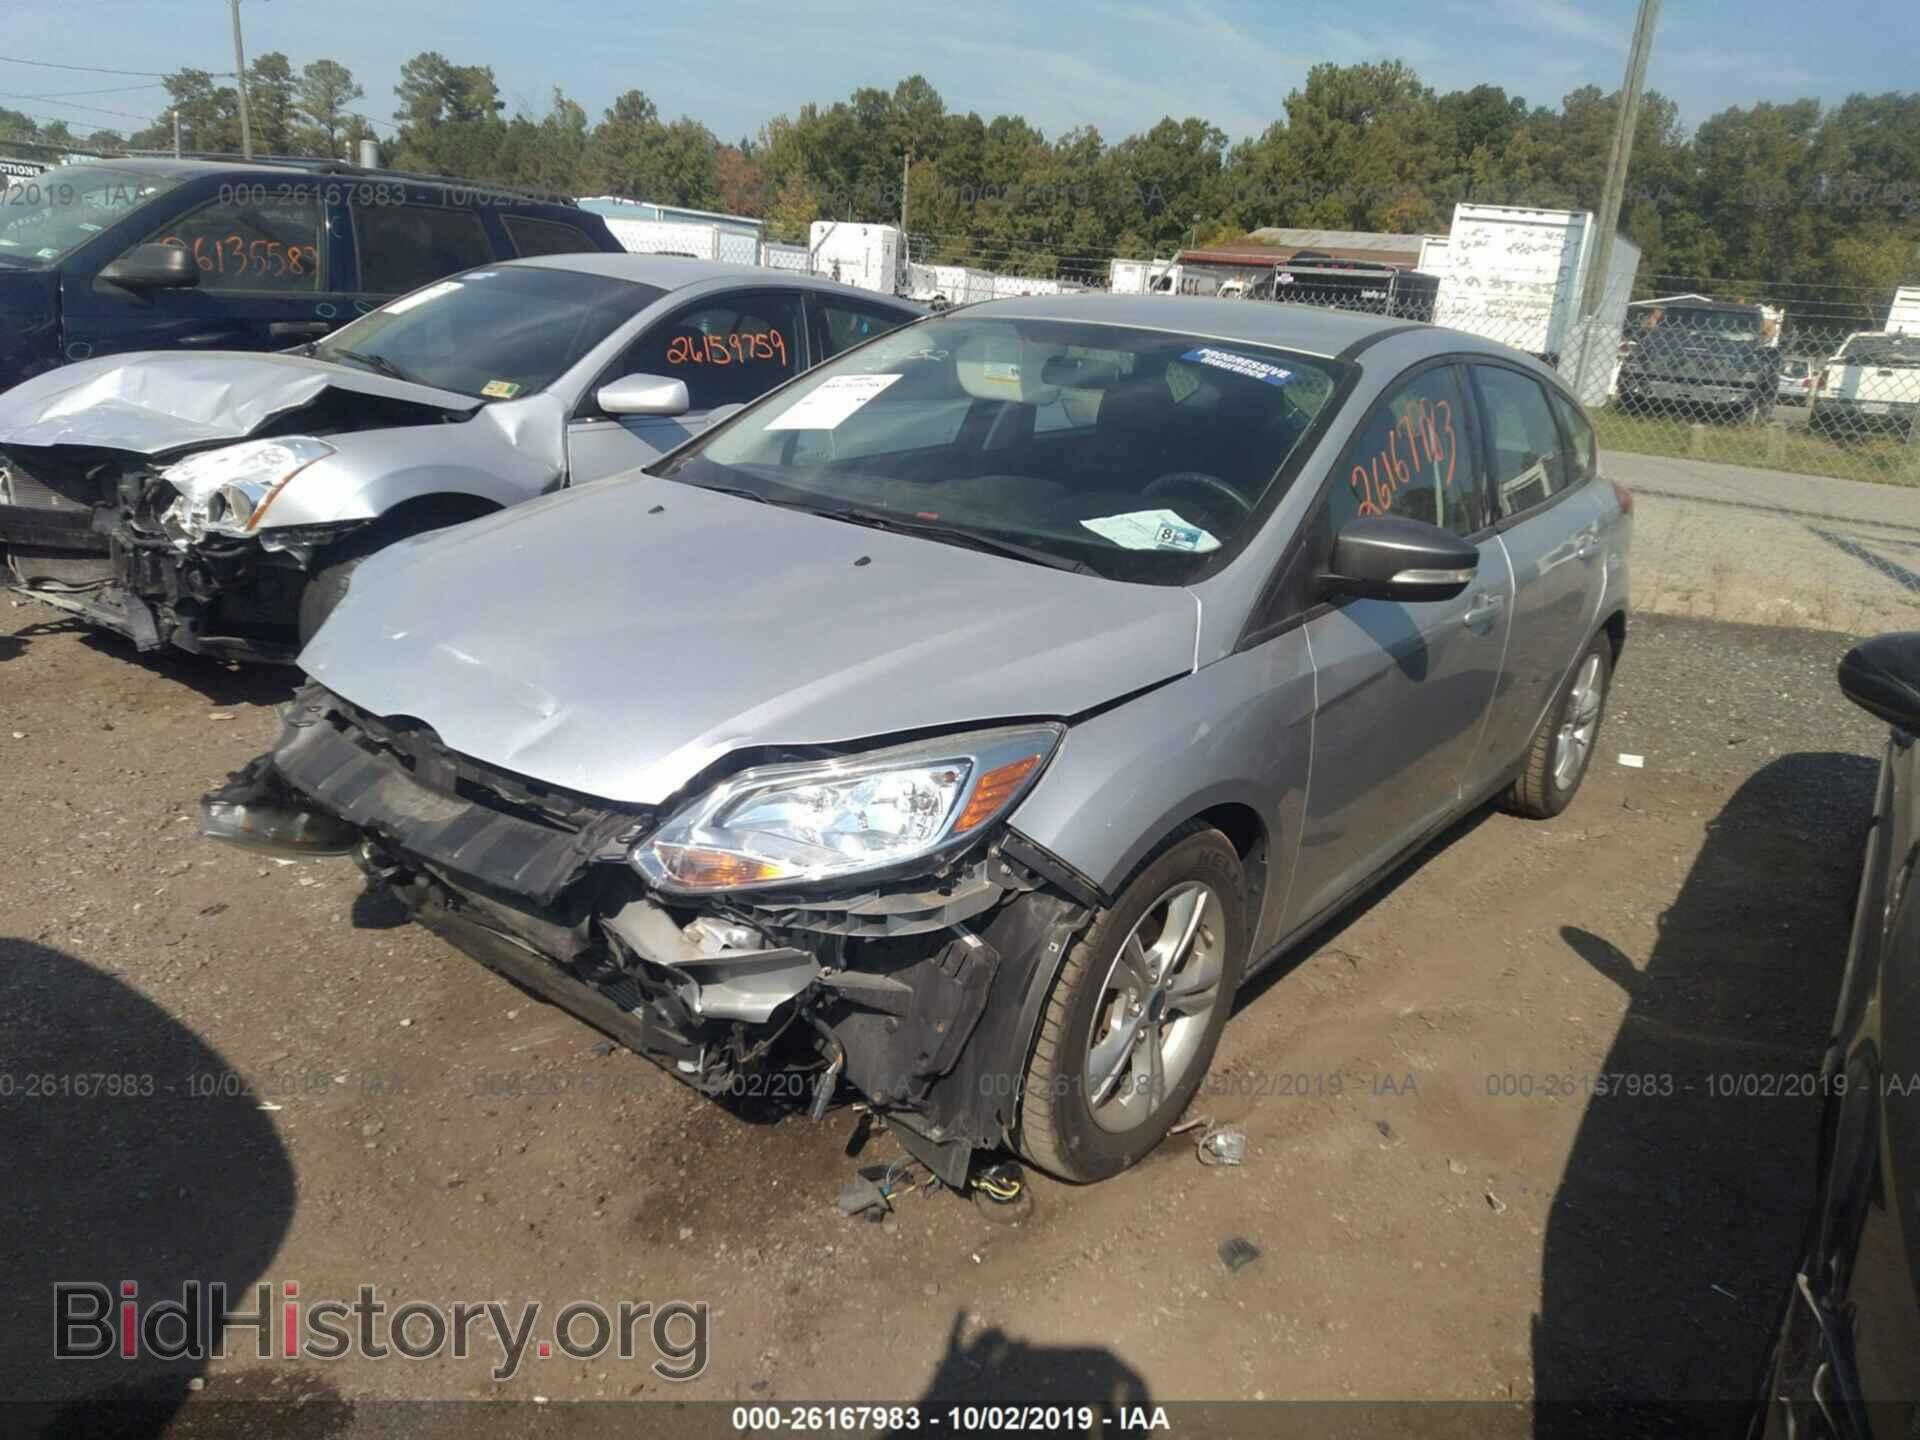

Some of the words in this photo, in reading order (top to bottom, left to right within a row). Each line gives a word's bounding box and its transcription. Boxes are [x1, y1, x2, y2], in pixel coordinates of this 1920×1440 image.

[666, 329, 787, 367] 26159759
[1198, 348, 1292, 379] PROGRESSIVE
[1161, 528, 1173, 540] 8
